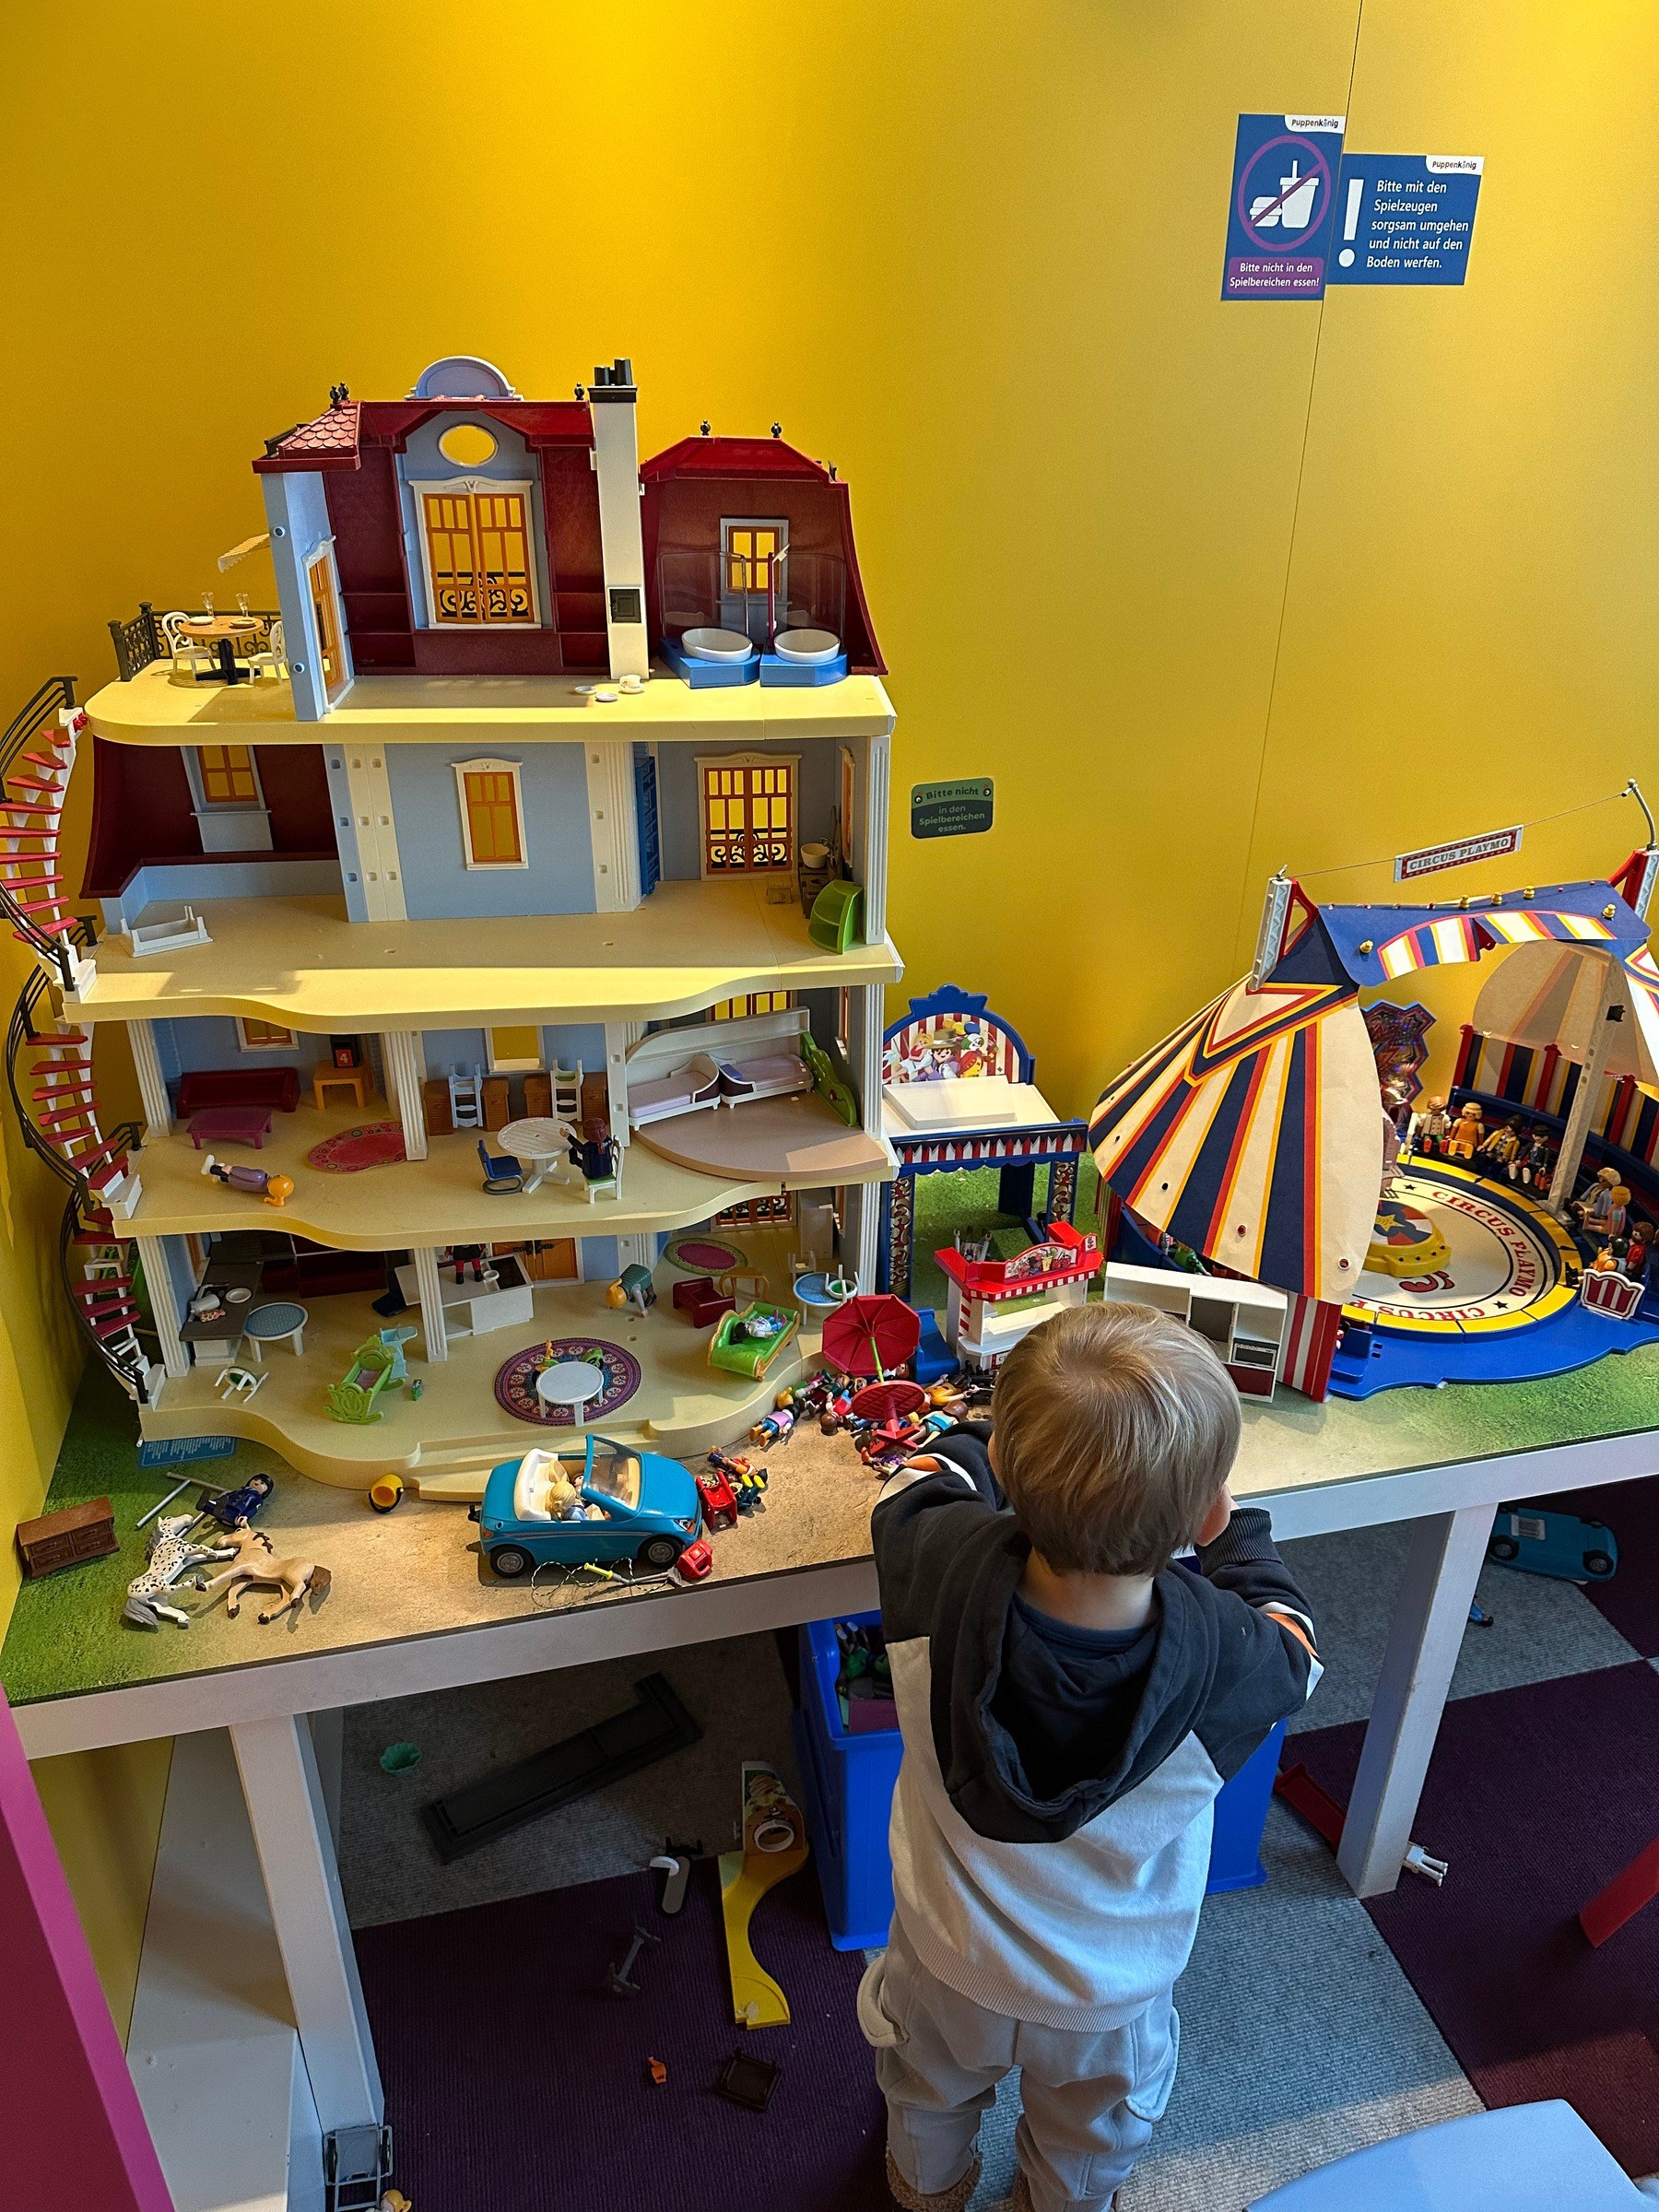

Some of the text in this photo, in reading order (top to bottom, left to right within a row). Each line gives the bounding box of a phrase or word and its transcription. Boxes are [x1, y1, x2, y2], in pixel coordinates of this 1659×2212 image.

[1376, 180, 1447, 194] Bitte mit den
[1373, 199, 1438, 216] Spielzeugen
[1371, 219, 1469, 234] sorgsam umgehen
[1369, 237, 1463, 250] und nicht auf den
[1240, 263, 1313, 273] Bitte nicht in den
[1366, 255, 1442, 268] Boden werfen.
[1230, 277, 1320, 289] Spielbereichen essen!
[926, 787, 979, 799] Bitte nicht
[919, 813, 985, 826] Spielbereichen
[1409, 838, 1509, 870] CIRCUS PLAYMO
[340, 1053, 349, 1064] 4
[1431, 1191, 1536, 1297] CIRCUS PLAYMO
